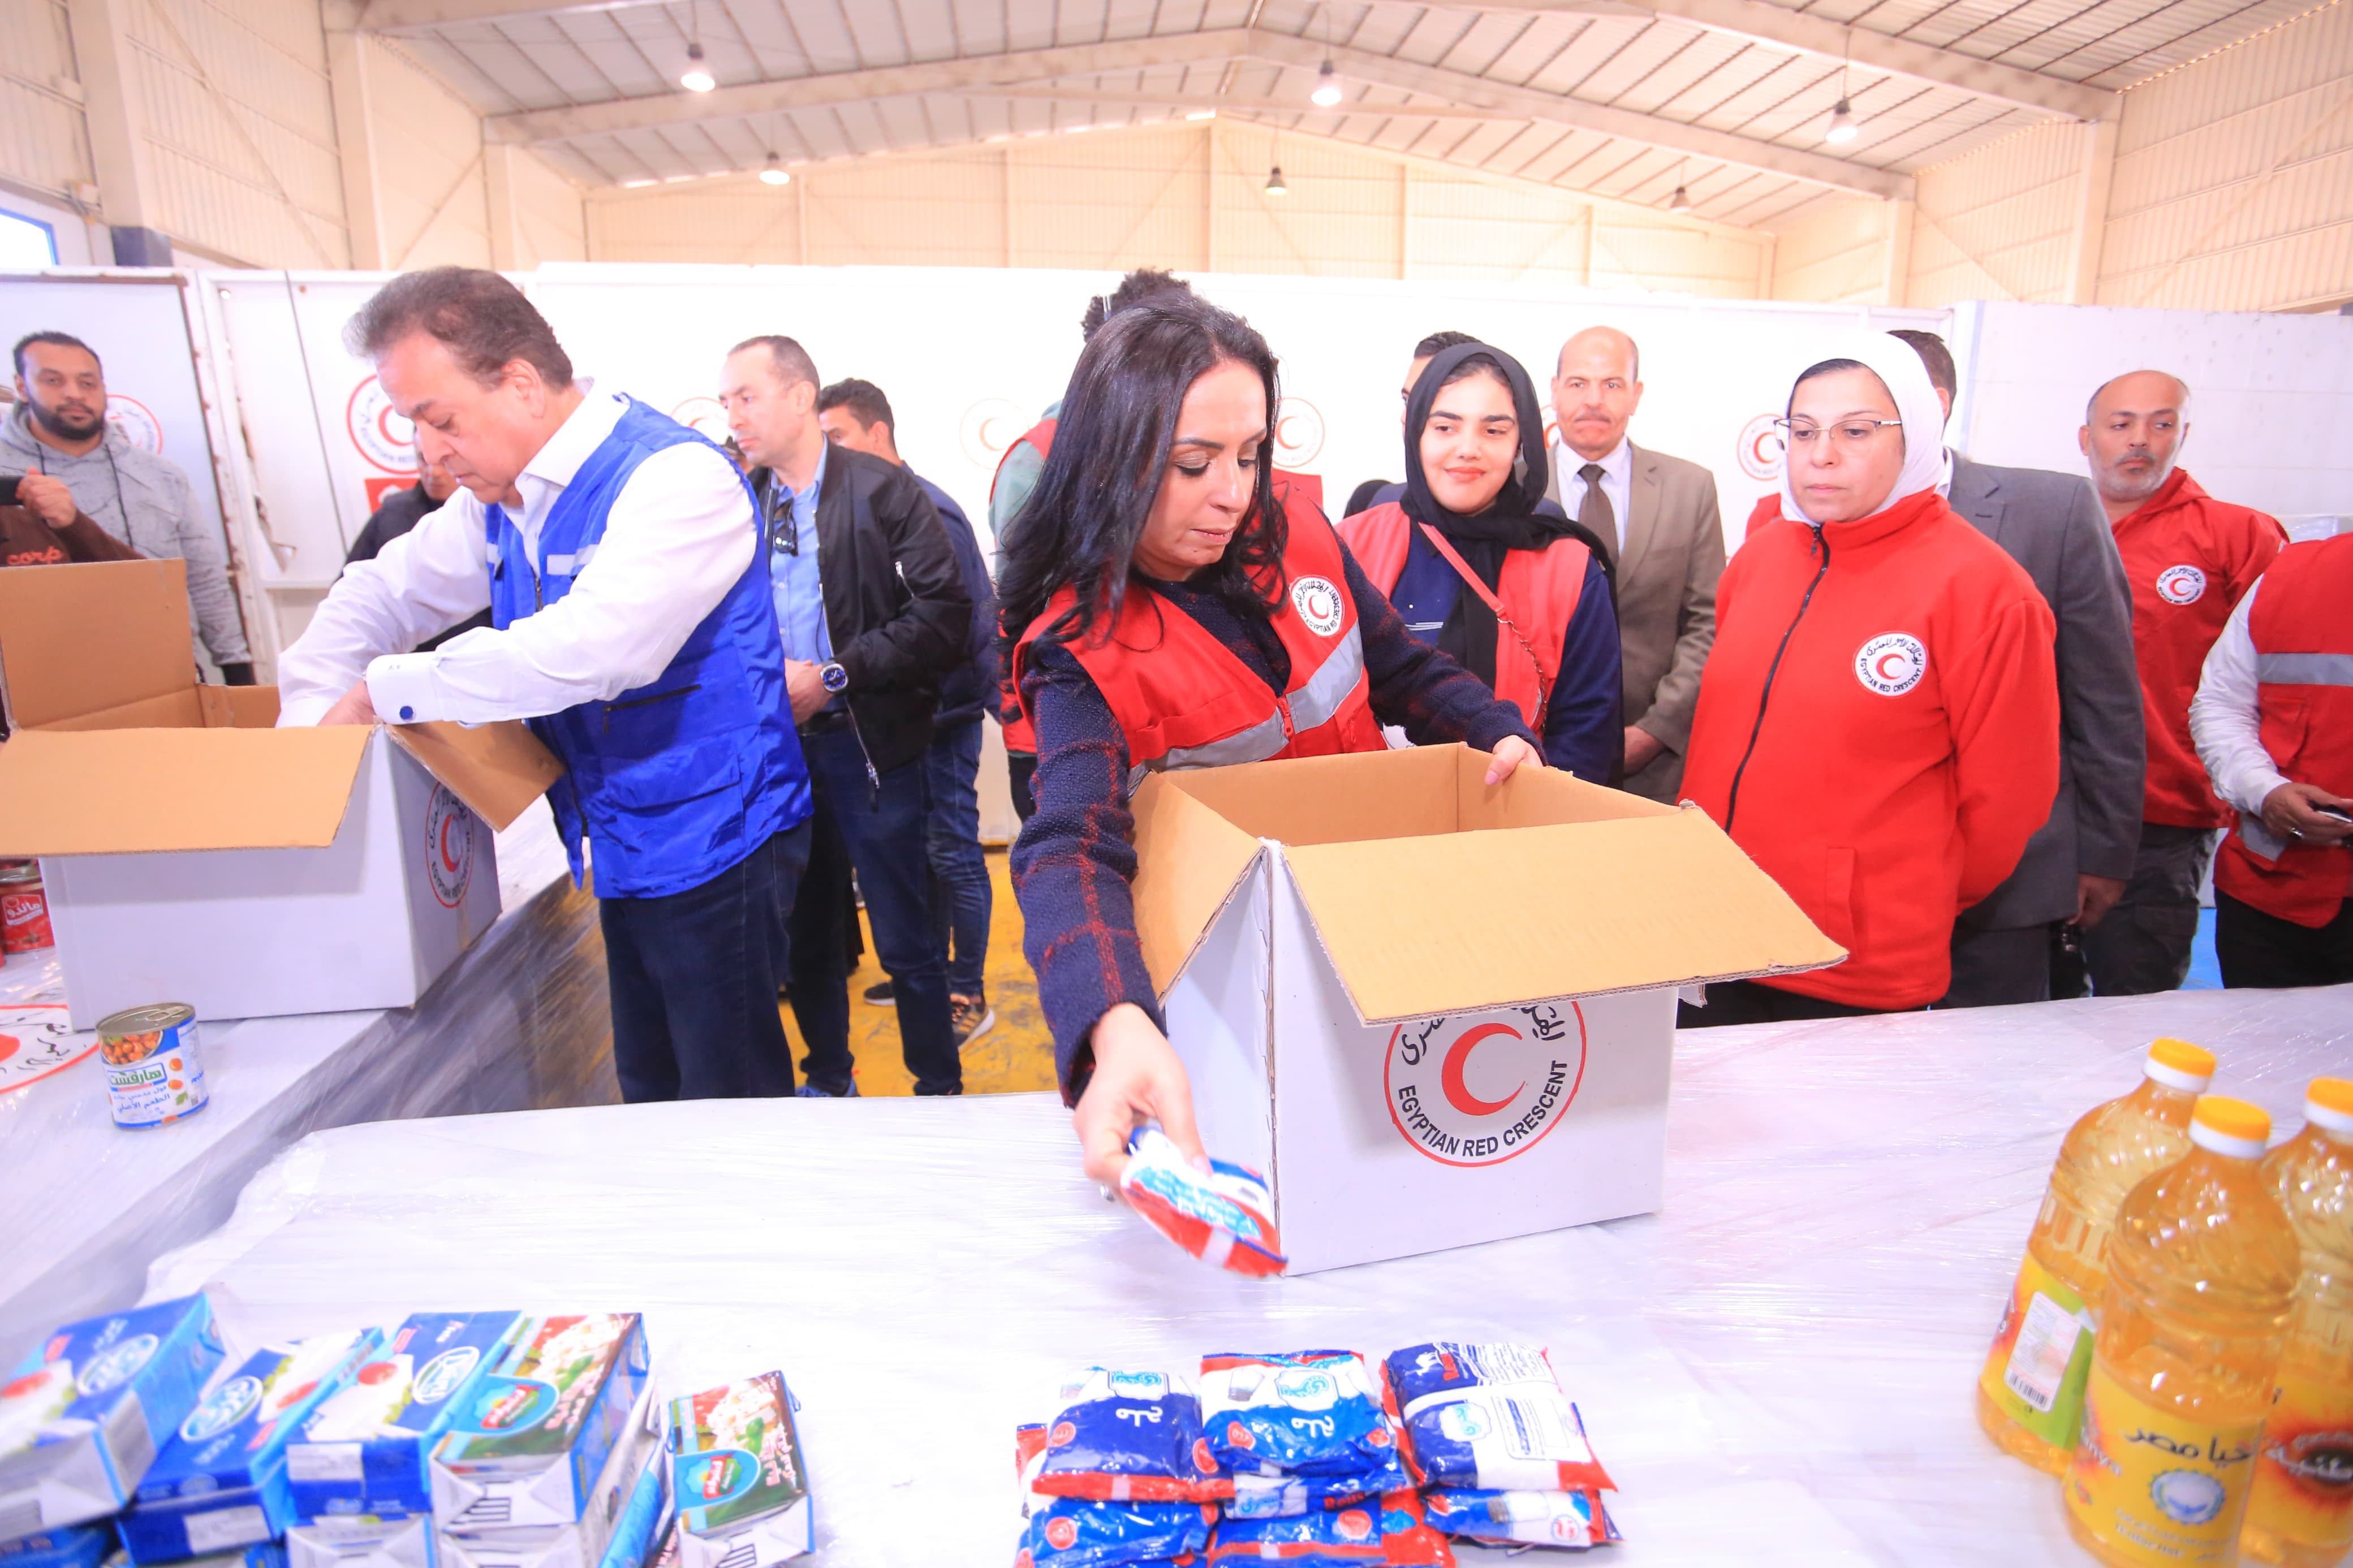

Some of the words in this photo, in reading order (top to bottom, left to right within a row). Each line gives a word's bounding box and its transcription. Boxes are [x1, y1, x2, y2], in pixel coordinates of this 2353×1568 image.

[1878, 684, 1891, 692] RED
[1893, 668, 1922, 693] CRESCENT
[1398, 1085, 1460, 1155] EGYPTIAN
[1462, 1137, 1499, 1157] RED
[1502, 1060, 1567, 1146] CRESCENT
[1115, 1406, 1163, 1427] ملح
[1291, 1415, 1334, 1438] ملح
[2123, 1428, 2200, 1459] مصر
